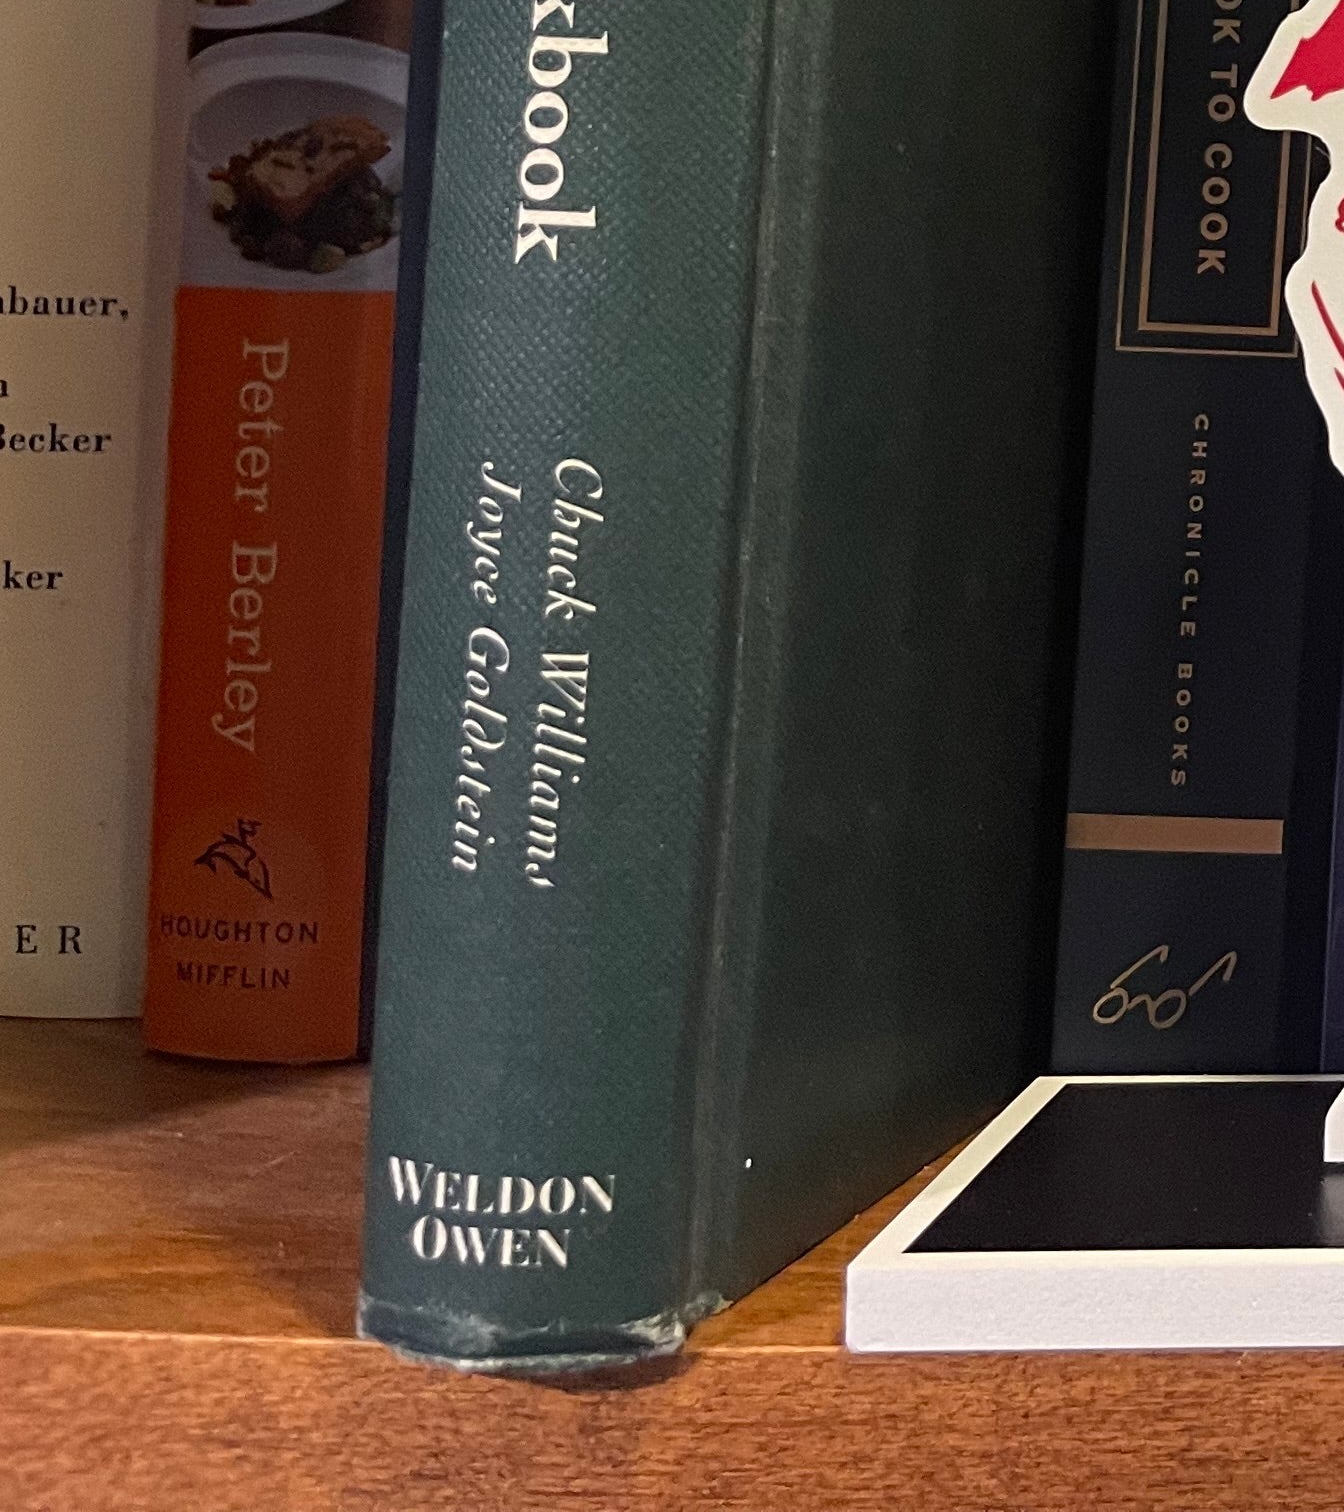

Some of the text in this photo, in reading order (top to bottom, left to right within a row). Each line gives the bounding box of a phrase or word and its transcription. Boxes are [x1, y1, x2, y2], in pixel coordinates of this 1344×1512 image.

[1207, 63, 1237, 123] TO
[1196, 141, 1233, 276] COOK
[0, 284, 129, 322] bauer,
[211, 337, 291, 754] Peter Berley
[1170, 413, 1210, 787] CHRONICLE BOOKS
[452, 460, 522, 873] Joyce Goldstein
[524, 457, 605, 888] Chuck Williams
[159, 914, 319, 945] HOUGHTON
[175, 961, 291, 989] MIFFLIN
[387, 1154, 617, 1216] WELDON
[410, 1213, 570, 1270] OWEN
